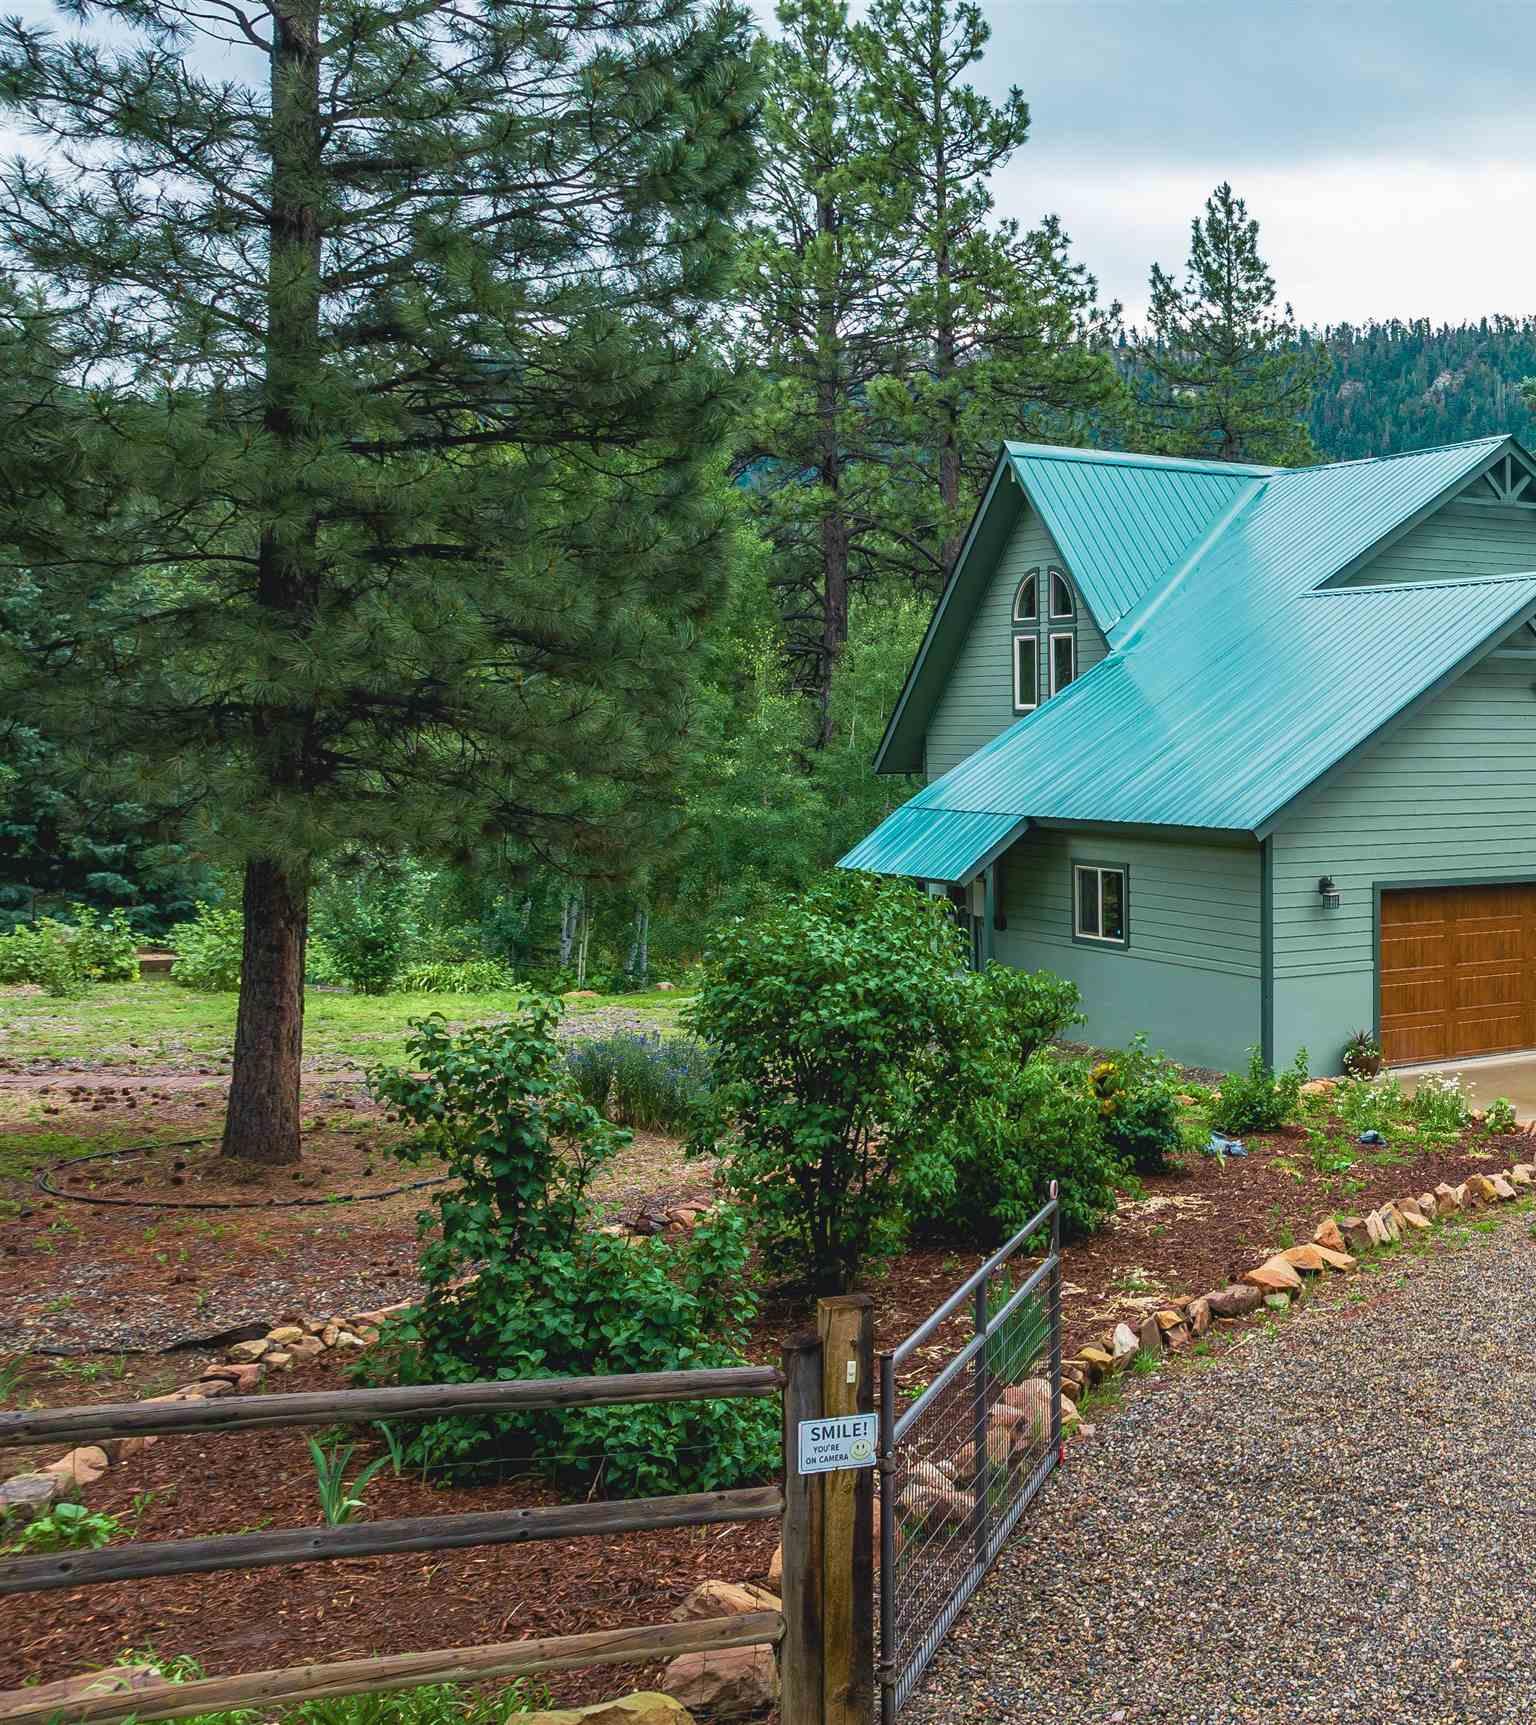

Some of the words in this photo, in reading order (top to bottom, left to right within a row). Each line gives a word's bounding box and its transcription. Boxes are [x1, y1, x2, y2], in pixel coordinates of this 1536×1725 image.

[811, 1422, 867, 1441] SMILE!
[813, 1444, 840, 1453] YOU'RE
[806, 1457, 817, 1465] ON
[819, 1453, 848, 1463] CAMERA
